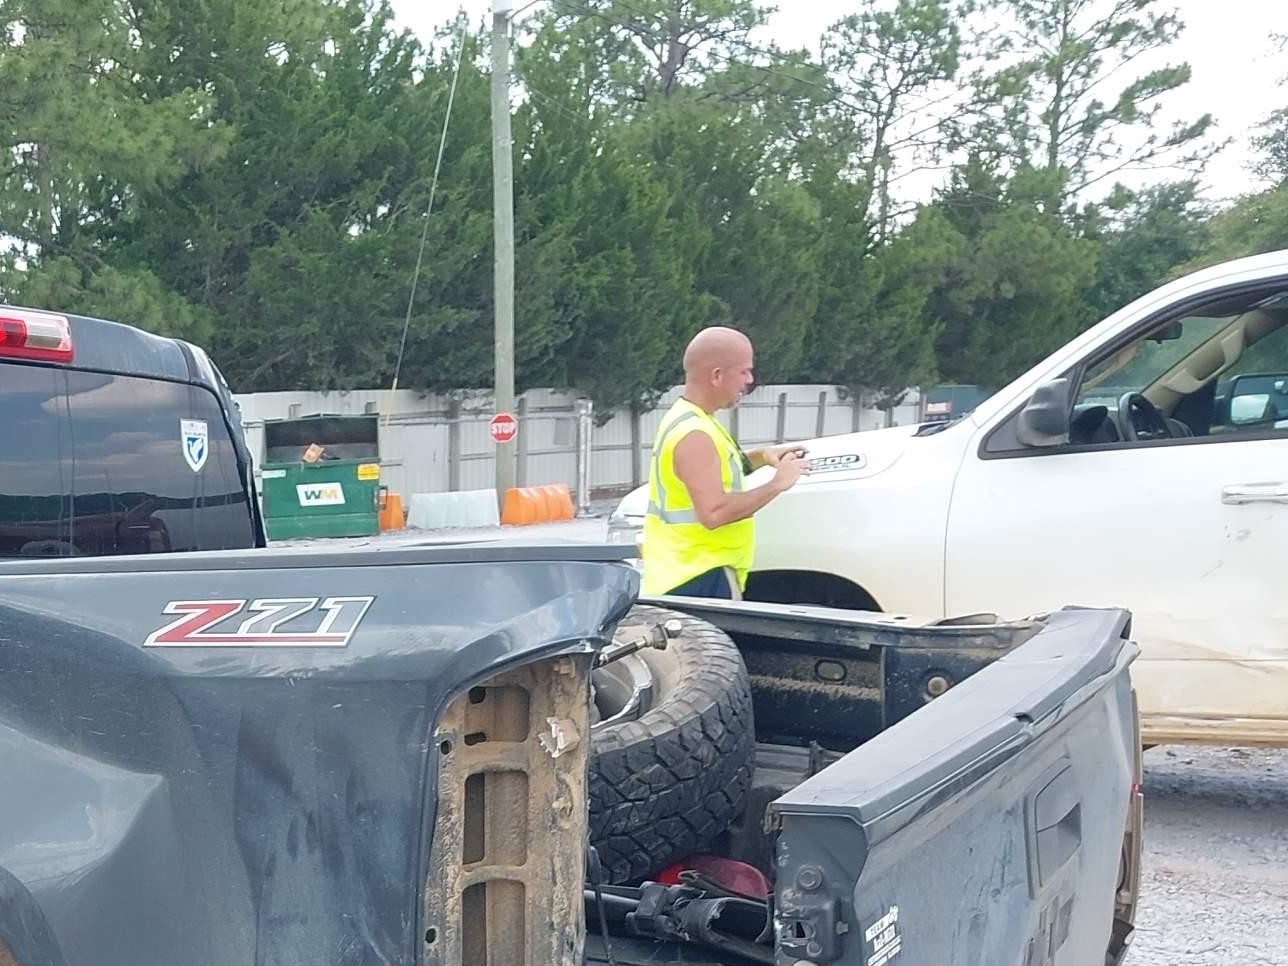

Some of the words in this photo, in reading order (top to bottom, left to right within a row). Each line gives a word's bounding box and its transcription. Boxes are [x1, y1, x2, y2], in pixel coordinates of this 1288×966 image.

[491, 421, 516, 435] STOP
[304, 488, 338, 501] WM
[143, 595, 376, 647] Z71
